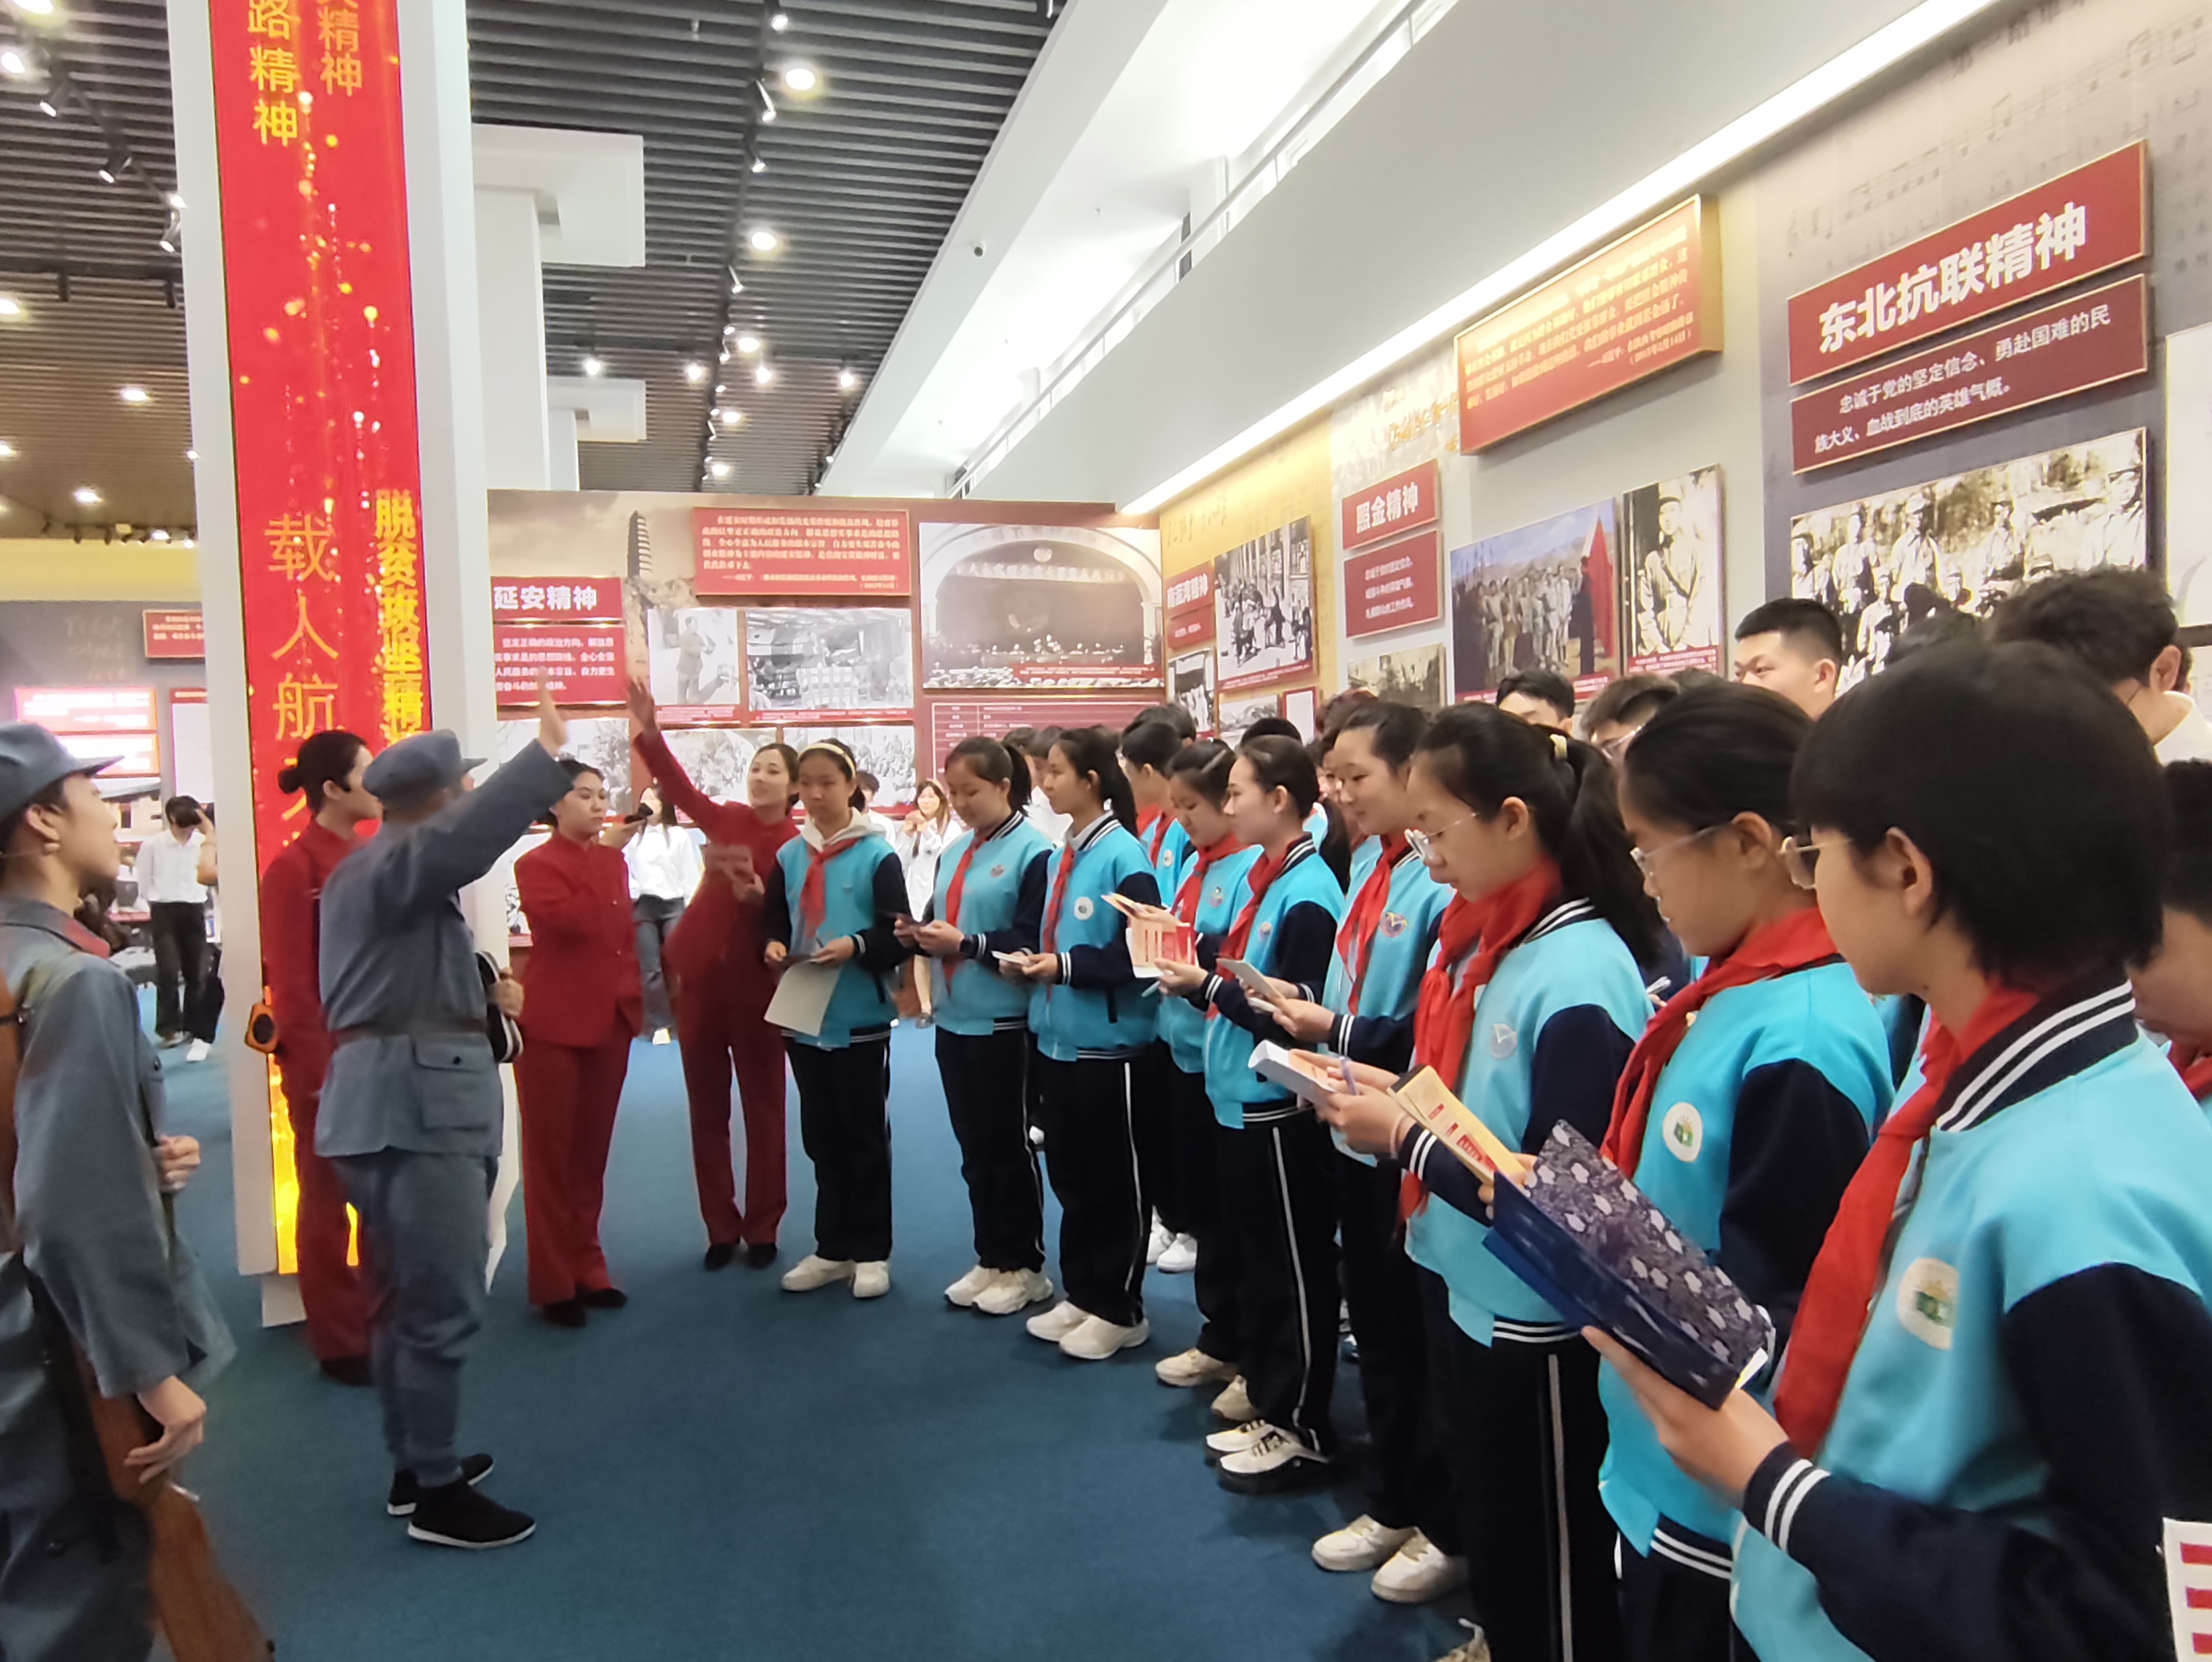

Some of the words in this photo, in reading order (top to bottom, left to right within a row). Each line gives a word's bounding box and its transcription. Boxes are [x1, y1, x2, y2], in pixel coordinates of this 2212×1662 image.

[316, 0, 363, 97] 精神
[1820, 202, 2087, 353] 东北抗联精神
[1356, 482, 1418, 534] 照金精神
[374, 490, 424, 746] 脱贫攻坚精
[494, 585, 597, 610] 延安精神
[264, 513, 345, 821] 载人航
